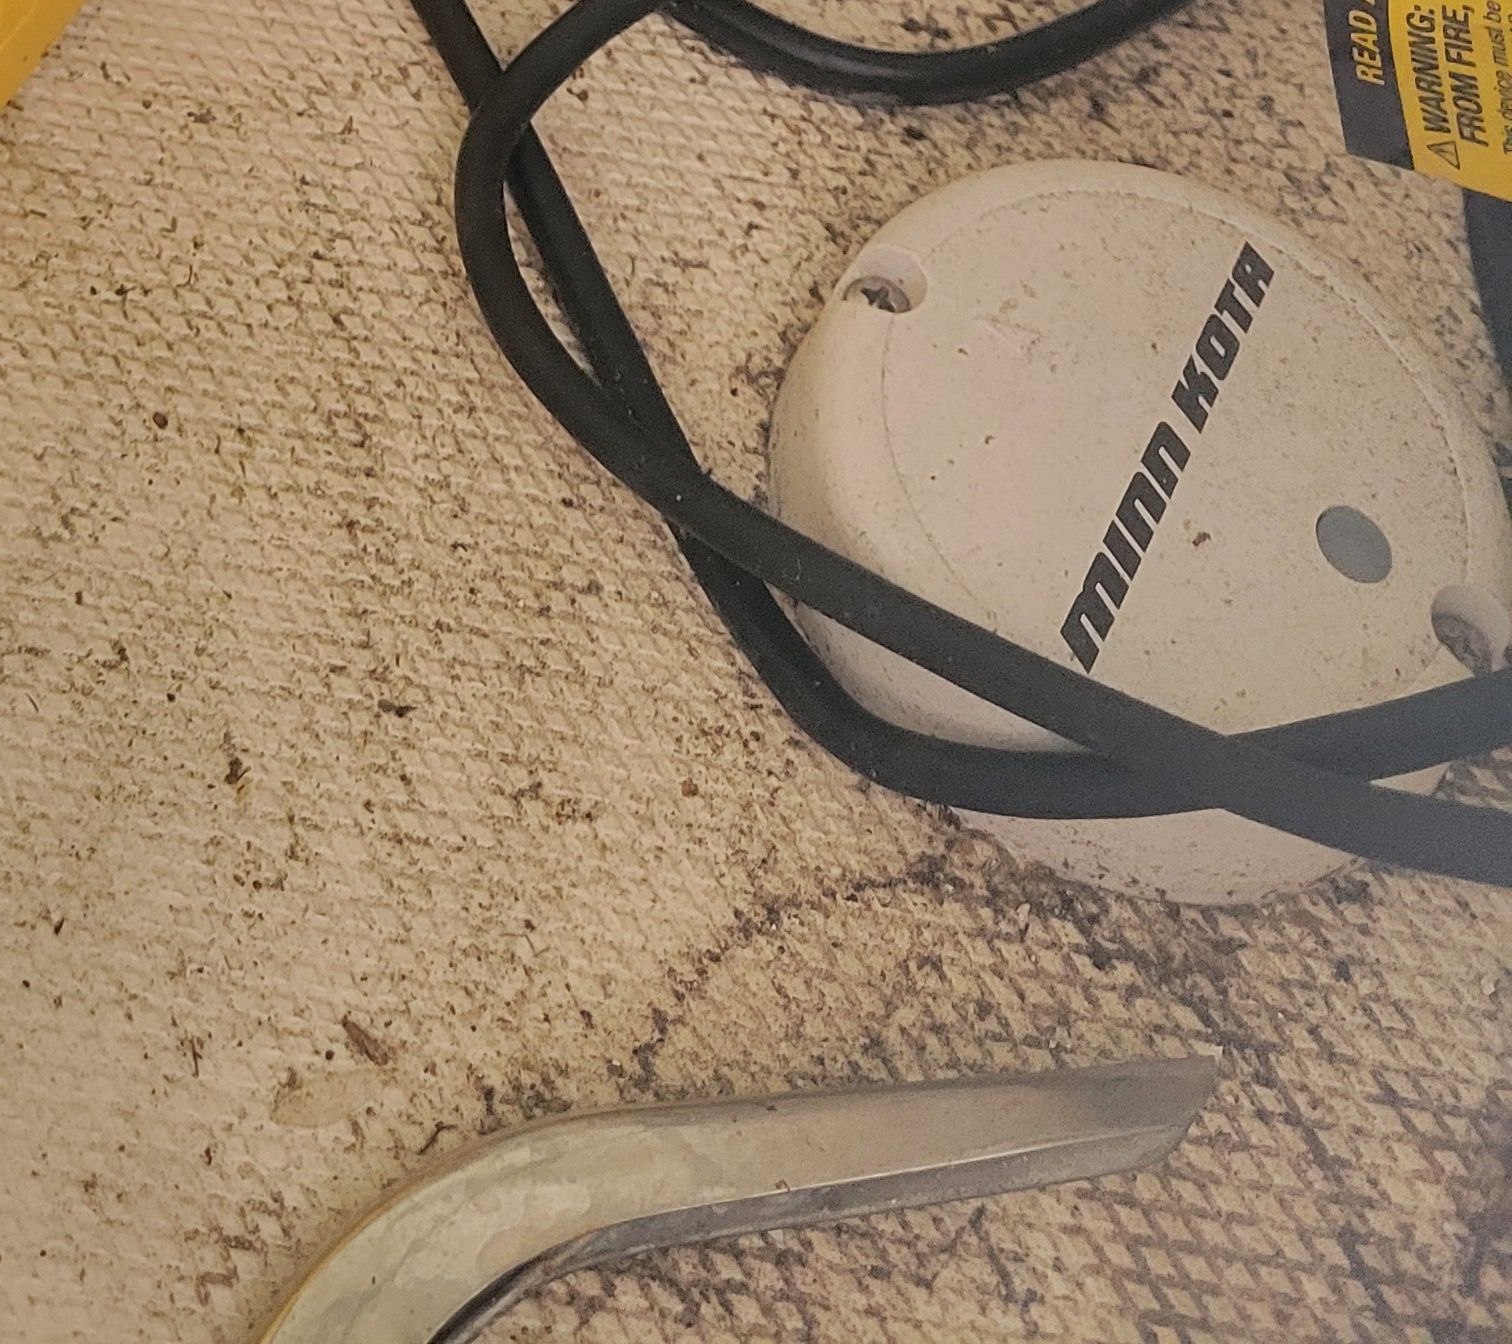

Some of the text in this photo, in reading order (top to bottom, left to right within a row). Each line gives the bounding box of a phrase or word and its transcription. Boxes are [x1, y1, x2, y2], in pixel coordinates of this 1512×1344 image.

[1437, 3, 1476, 65] FIRE,
[1477, 0, 1503, 24] be
[1482, 24, 1507, 68] must
[1347, 10, 1386, 85] READ
[1406, 4, 1451, 135] WARNING:
[1444, 70, 1489, 147] FROM
[1488, 70, 1512, 122] device
[1058, 240, 1275, 674] MINN KOTA
